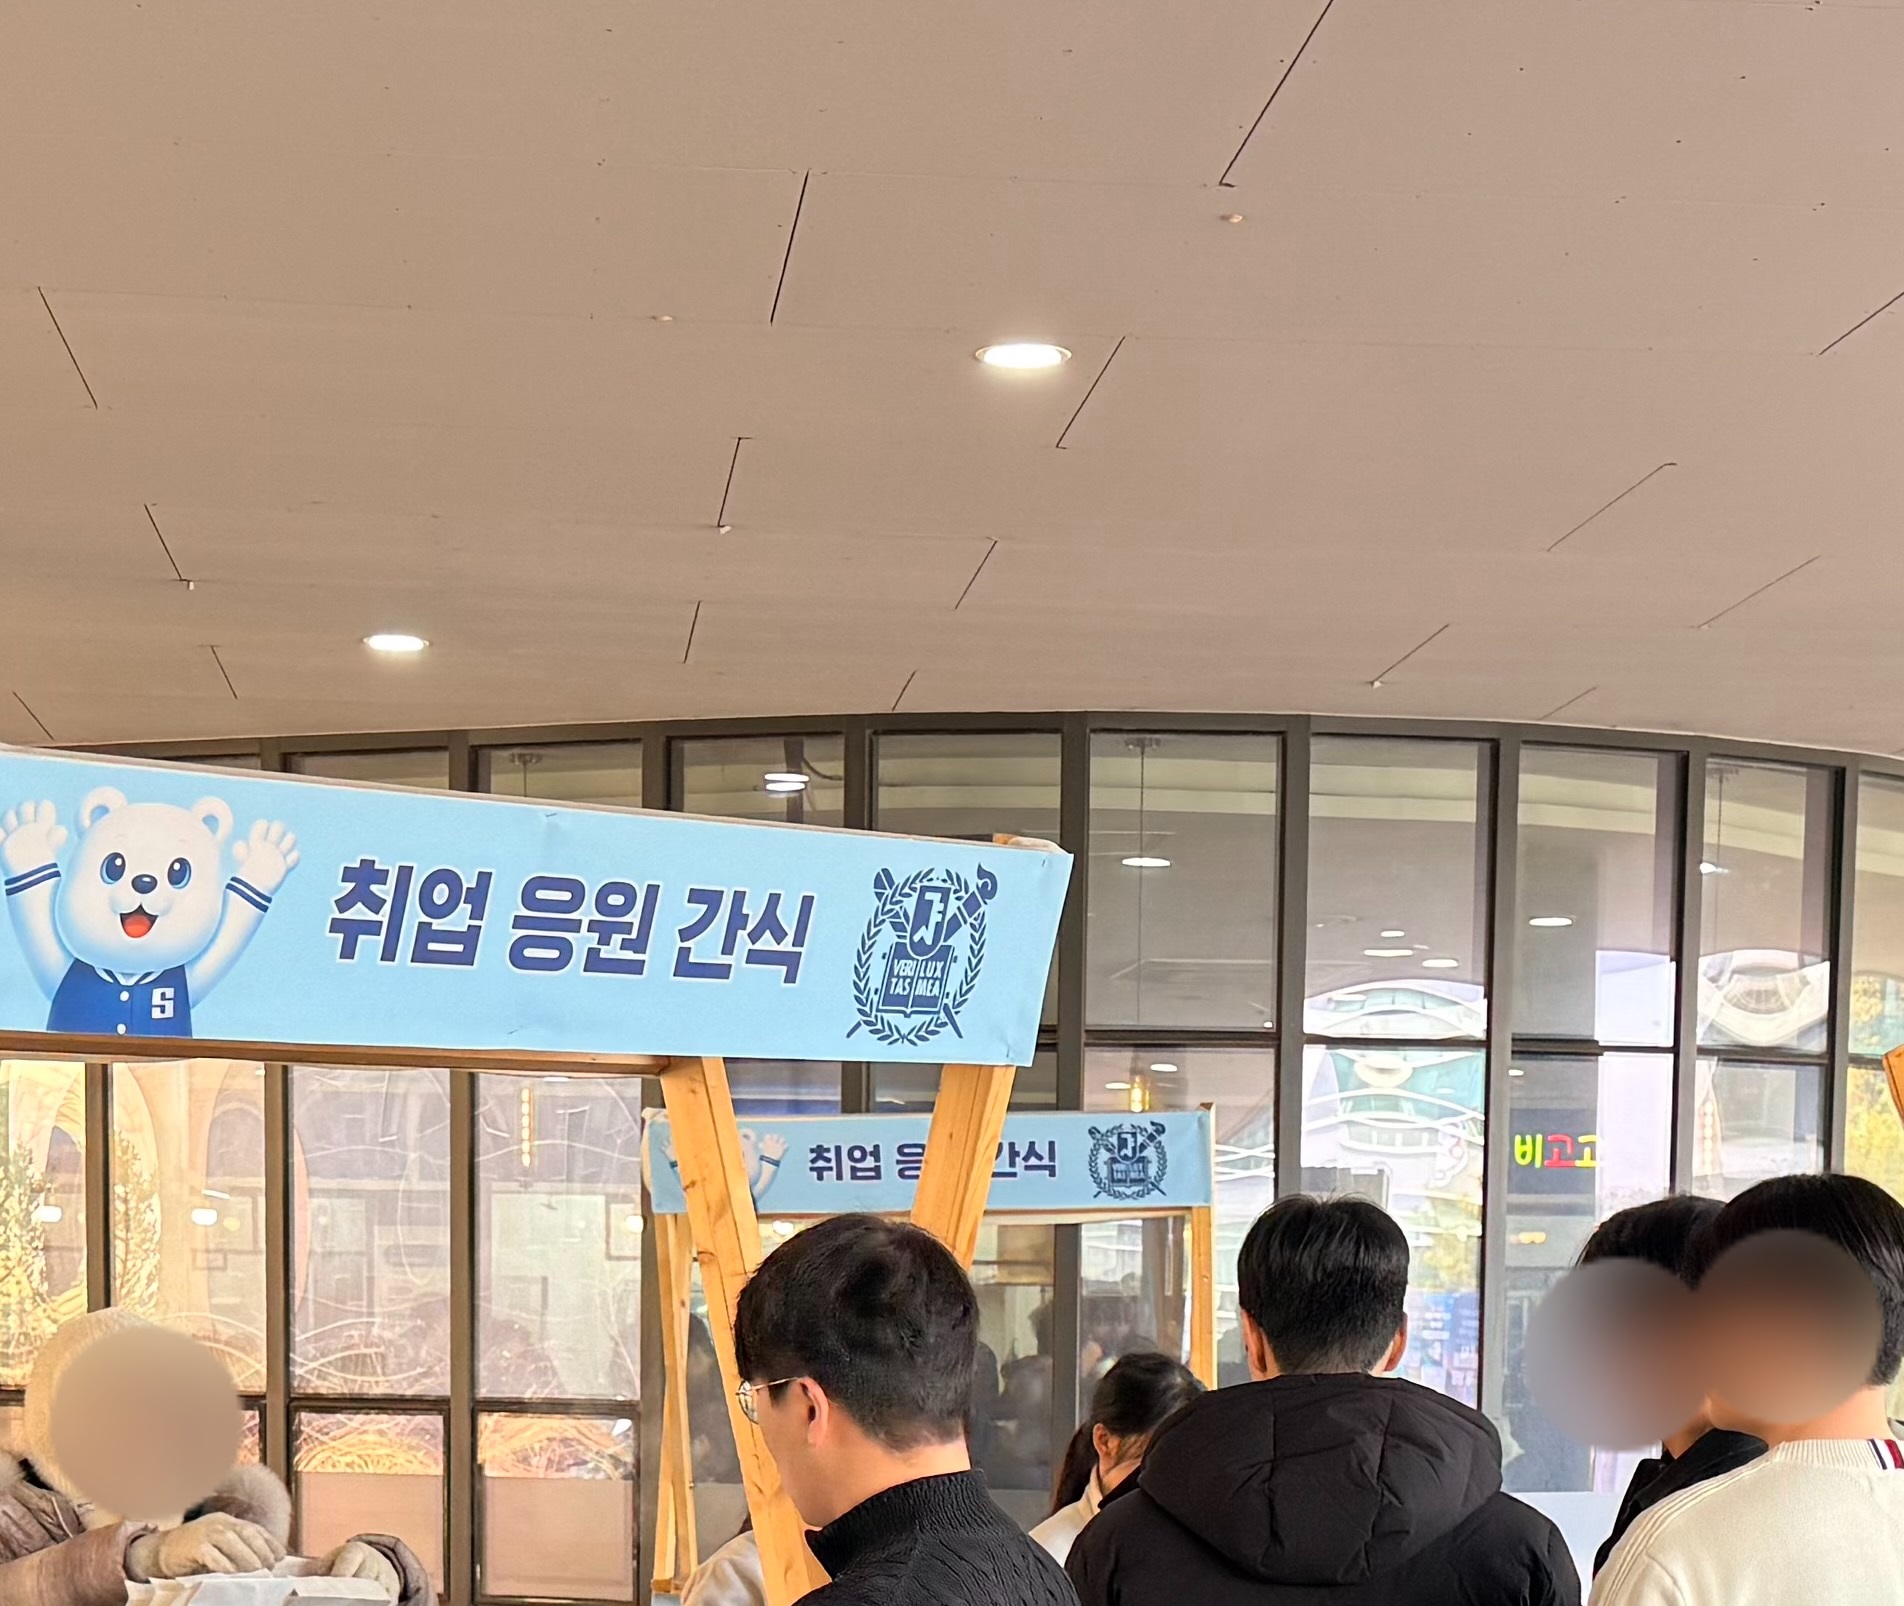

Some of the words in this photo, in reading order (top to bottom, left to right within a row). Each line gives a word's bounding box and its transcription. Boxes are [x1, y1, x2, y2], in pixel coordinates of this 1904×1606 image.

[327, 857, 494, 968] 취업
[507, 873, 662, 977] 응원
[671, 886, 816, 986] 간식
[893, 958, 917, 977] VERI
[919, 960, 945, 979] LUX
[889, 977, 912, 996] TAS
[914, 978, 942, 997] MEA
[151, 986, 175, 1019] S
[808, 1143, 883, 1182] 취업
[895, 1142, 929, 1180] 응
